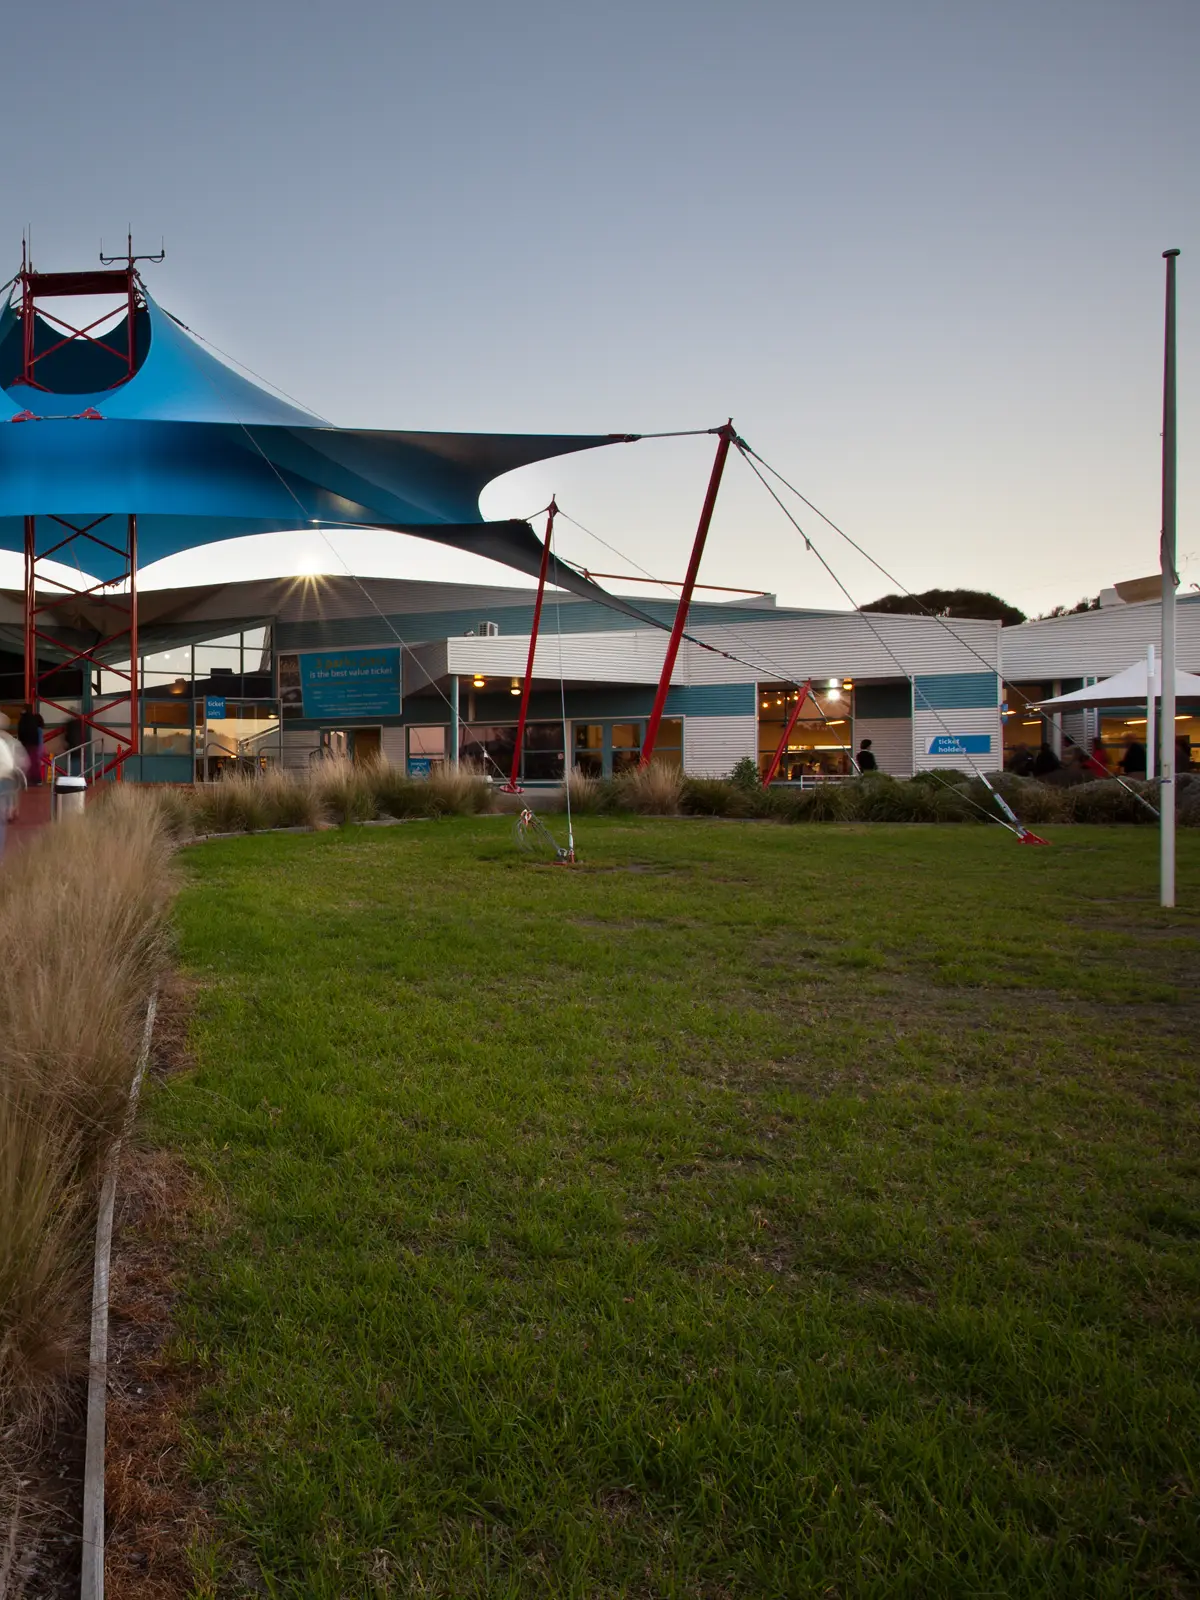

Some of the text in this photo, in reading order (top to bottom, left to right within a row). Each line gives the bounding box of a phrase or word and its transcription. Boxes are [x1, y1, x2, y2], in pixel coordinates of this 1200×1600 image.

[310, 666, 392, 679] is the best value ticket
